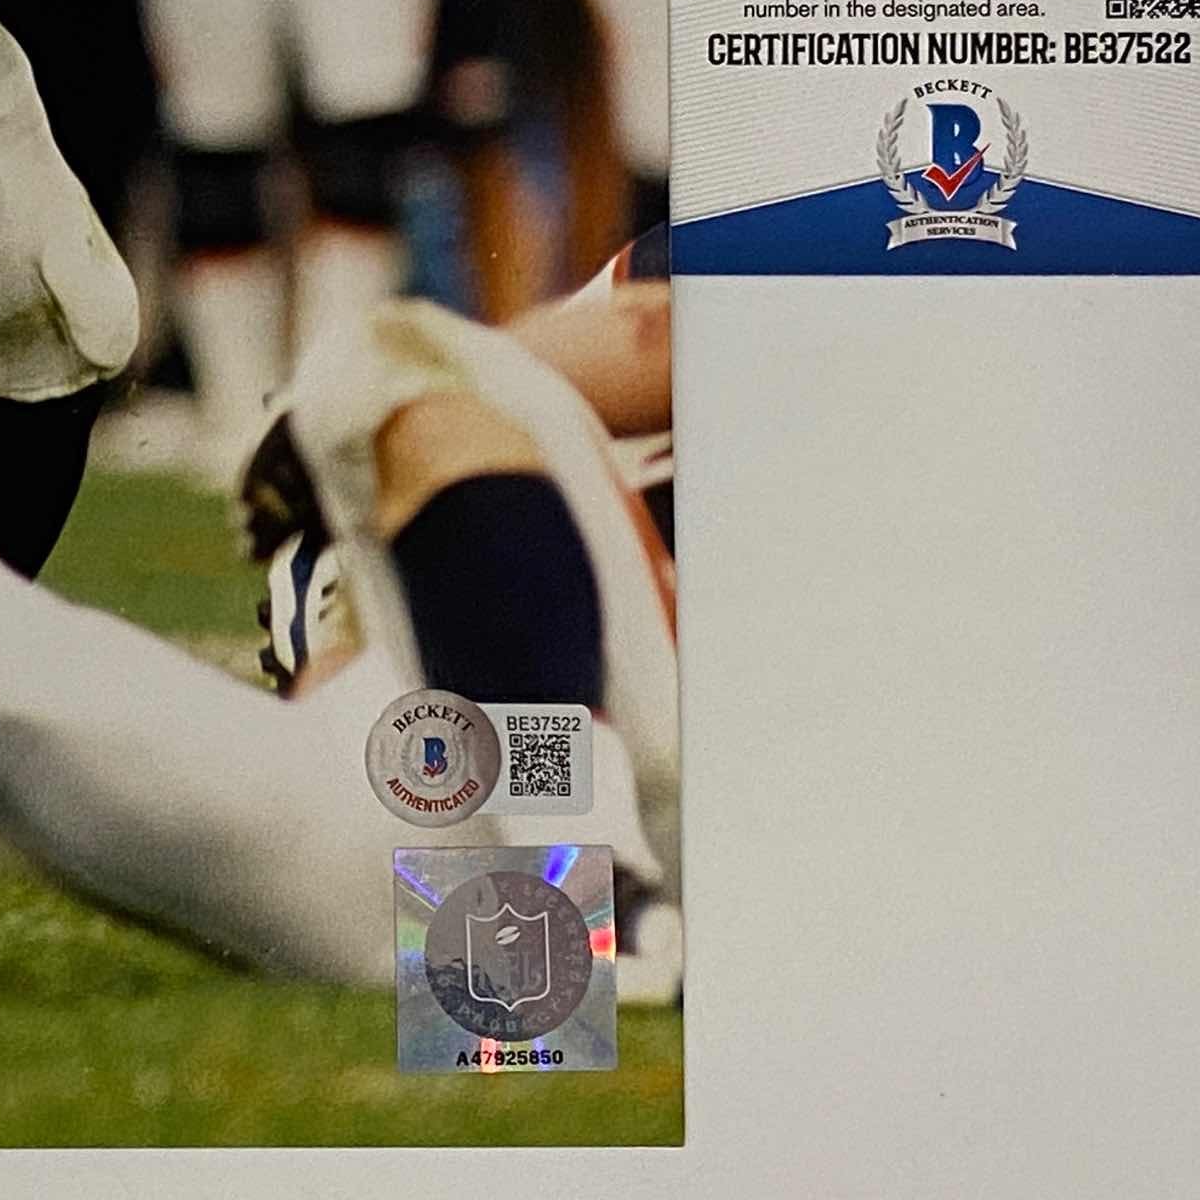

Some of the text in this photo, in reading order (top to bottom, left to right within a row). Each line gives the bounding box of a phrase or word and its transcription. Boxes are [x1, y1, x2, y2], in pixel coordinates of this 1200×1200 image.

[996, 2, 1046, 18] area.
[708, 31, 1192, 66] CERTIFICATION NUMBER: BE37522
[913, 78, 993, 99] BECKETT
[904, 215, 1000, 229] AUTHENTICATION
[926, 226, 977, 236] SERVICES
[391, 704, 476, 734] BECKETT
[506, 715, 582, 732] BE37522
[386, 777, 481, 813] AUTHENTICATED
[456, 1049, 564, 1066] A47925850
